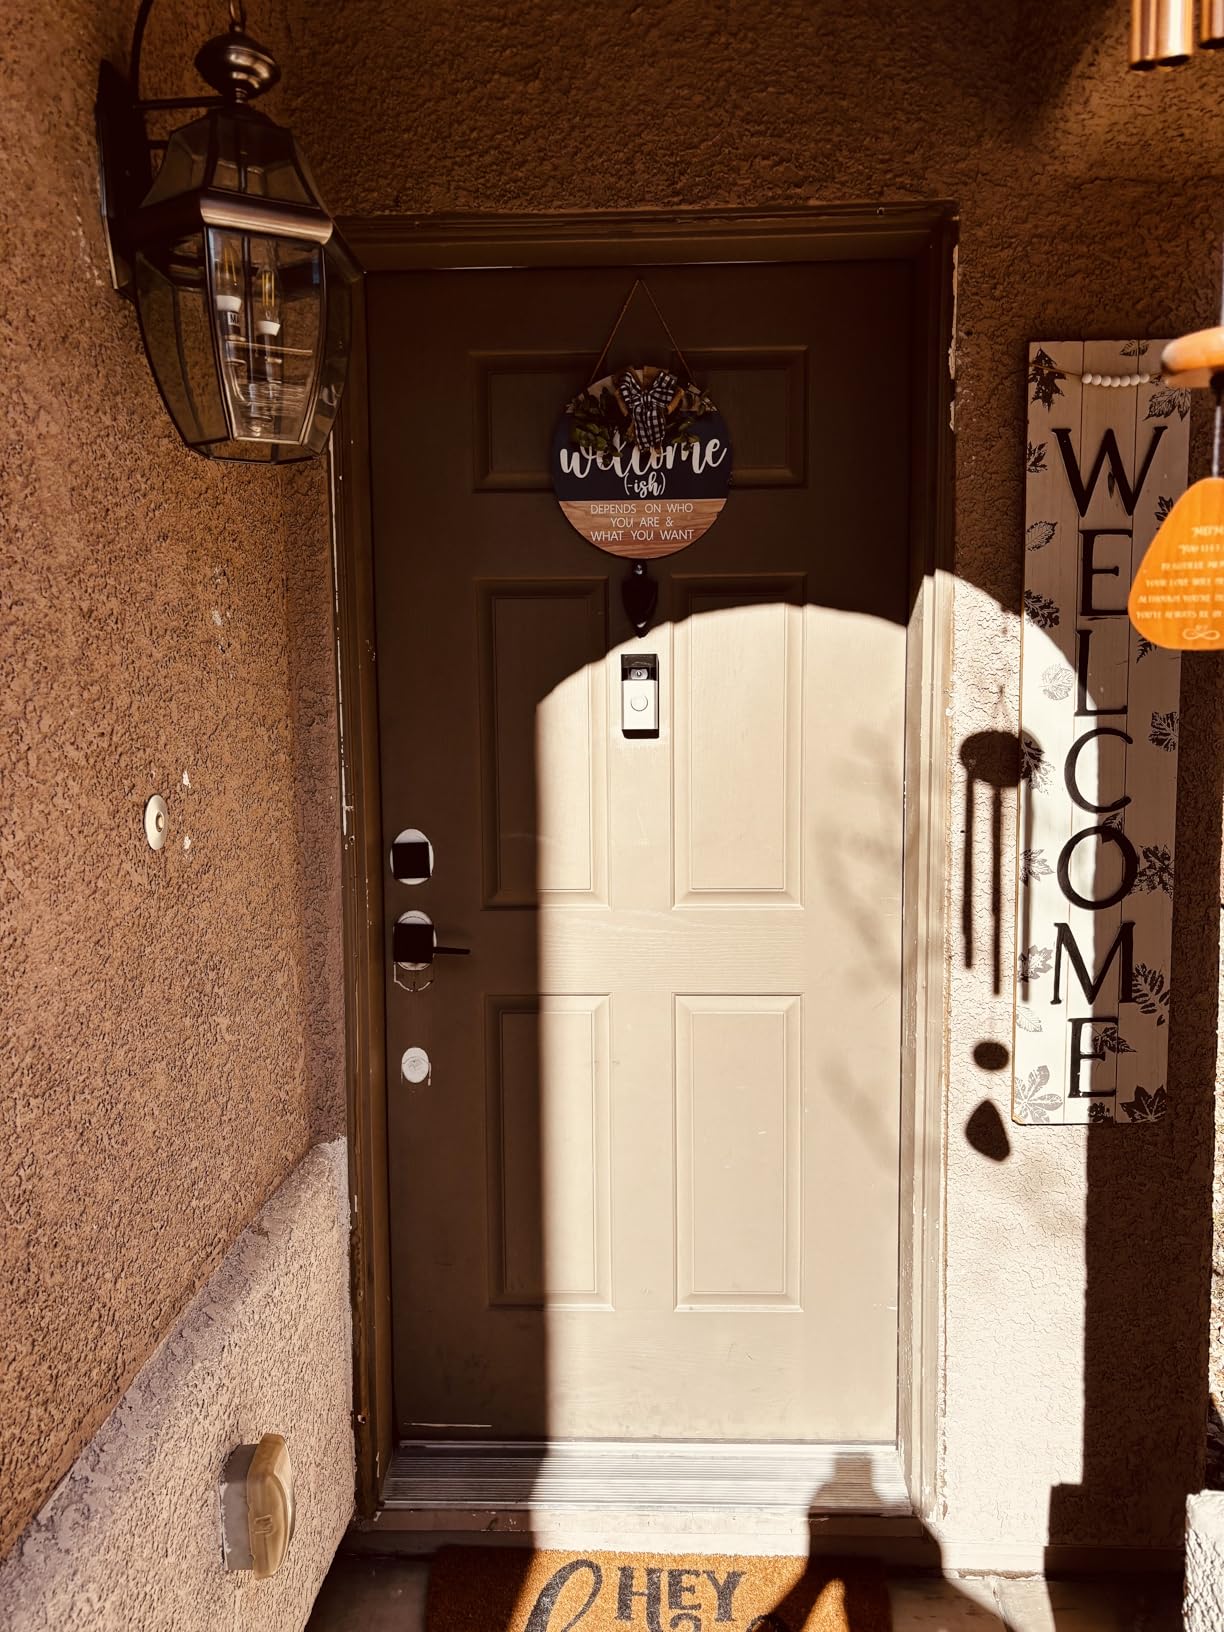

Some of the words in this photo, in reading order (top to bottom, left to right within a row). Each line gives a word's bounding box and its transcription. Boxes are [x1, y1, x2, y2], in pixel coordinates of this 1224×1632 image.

[590, 503, 637, 515] DEPENDS
[644, 503, 662, 514] ON
[667, 502, 694, 513] WHO
[610, 517, 634, 528] YOU
[639, 516, 660, 527] ARE
[665, 516, 675, 527] &
[590, 530, 625, 542] WHAT
[630, 529, 654, 541] YOU
[659, 529, 695, 541] WANT
[1050, 425, 1169, 1099] WELCOME
[614, 1565, 747, 1624] HEY
